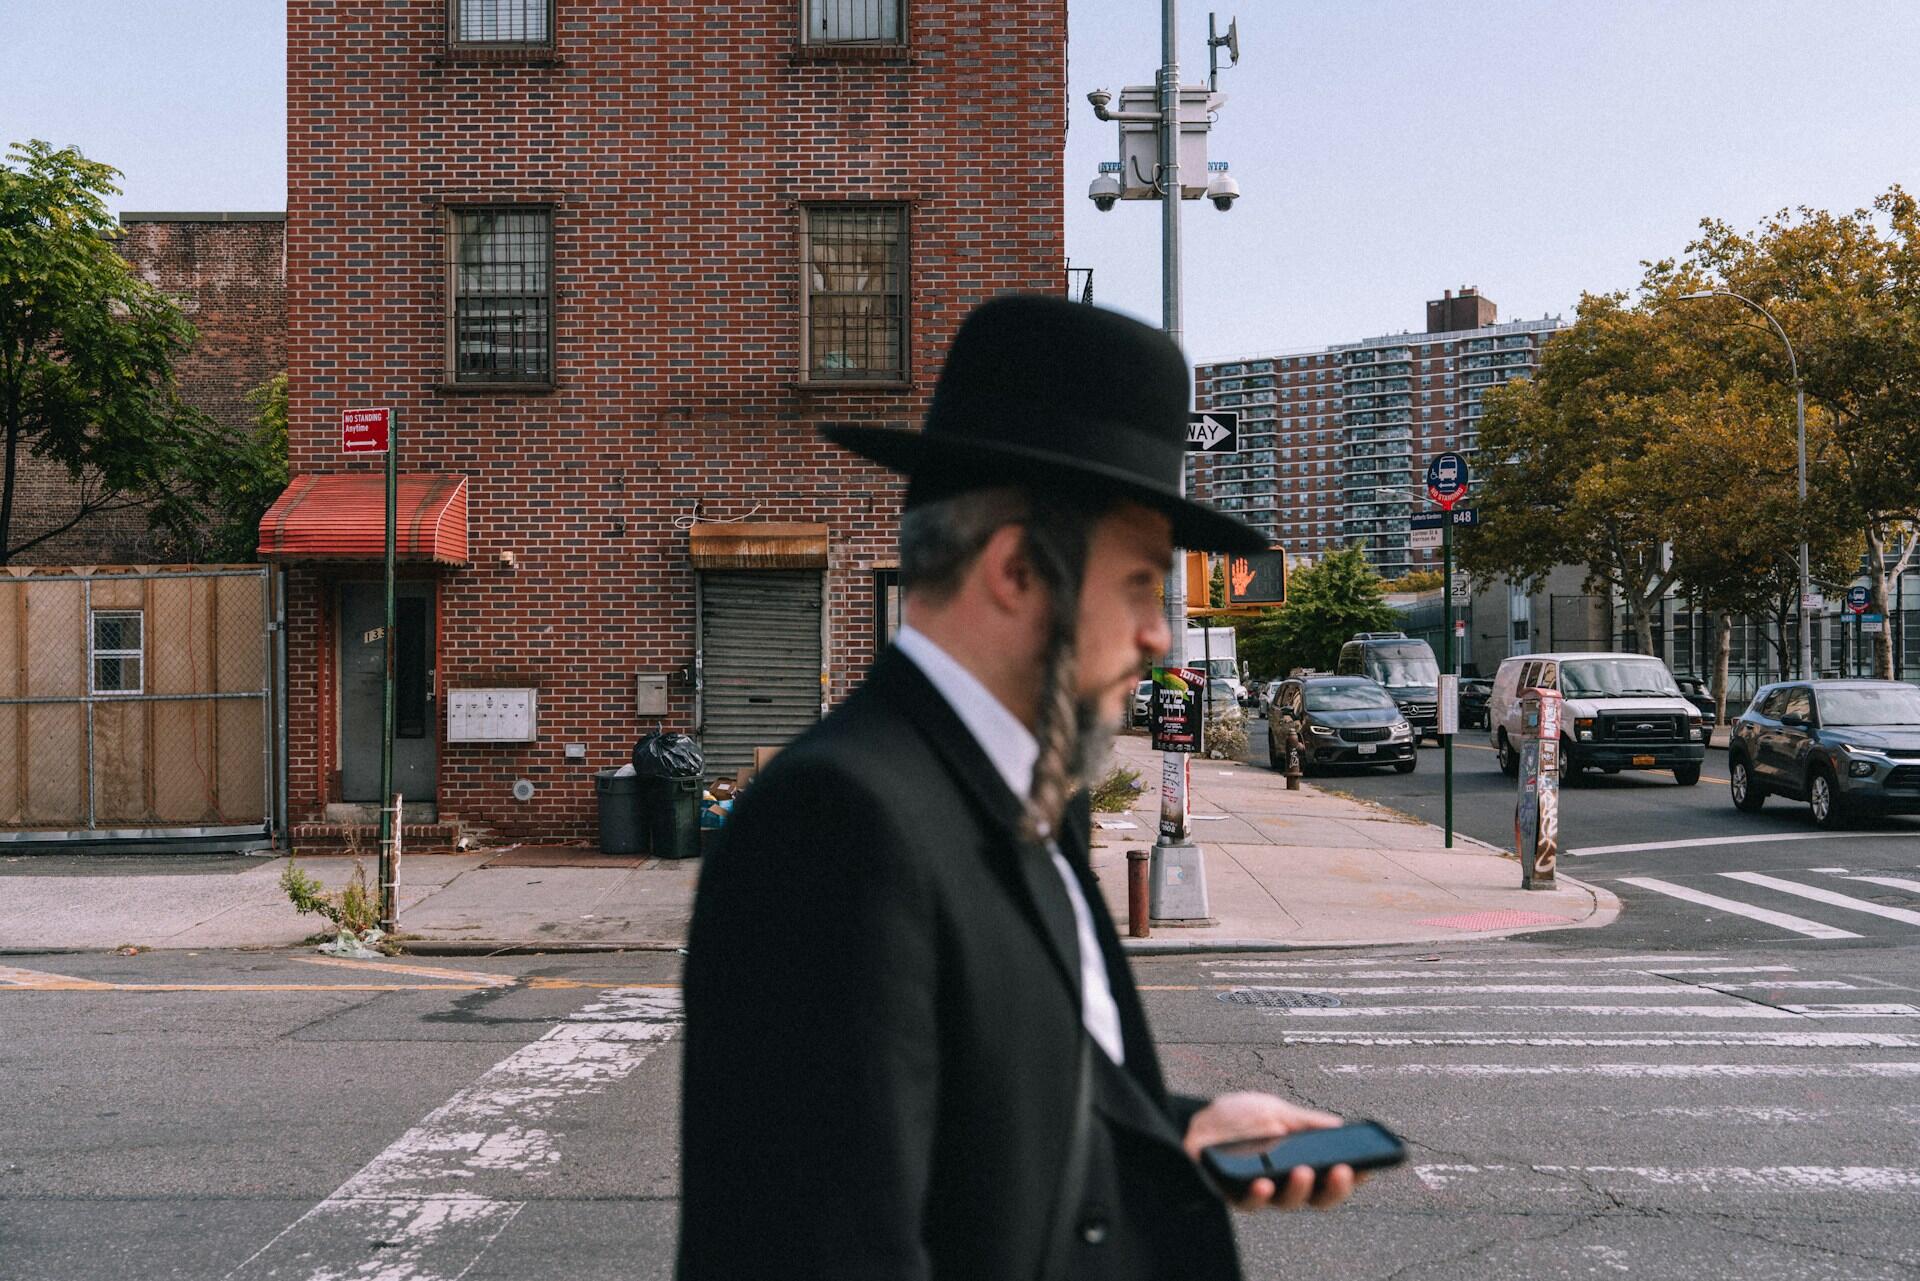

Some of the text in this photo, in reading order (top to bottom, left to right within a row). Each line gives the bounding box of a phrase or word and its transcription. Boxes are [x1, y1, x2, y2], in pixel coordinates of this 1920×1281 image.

[1101, 162, 1120, 171] NYPD
[1208, 161, 1229, 171] NYPD
[345, 413, 382, 423] NO STANDING
[345, 424, 369, 434] Anytime
[1185, 424, 1219, 440] WAY
[1453, 511, 1472, 523] B48
[1180, 668, 1204, 686] היום!
